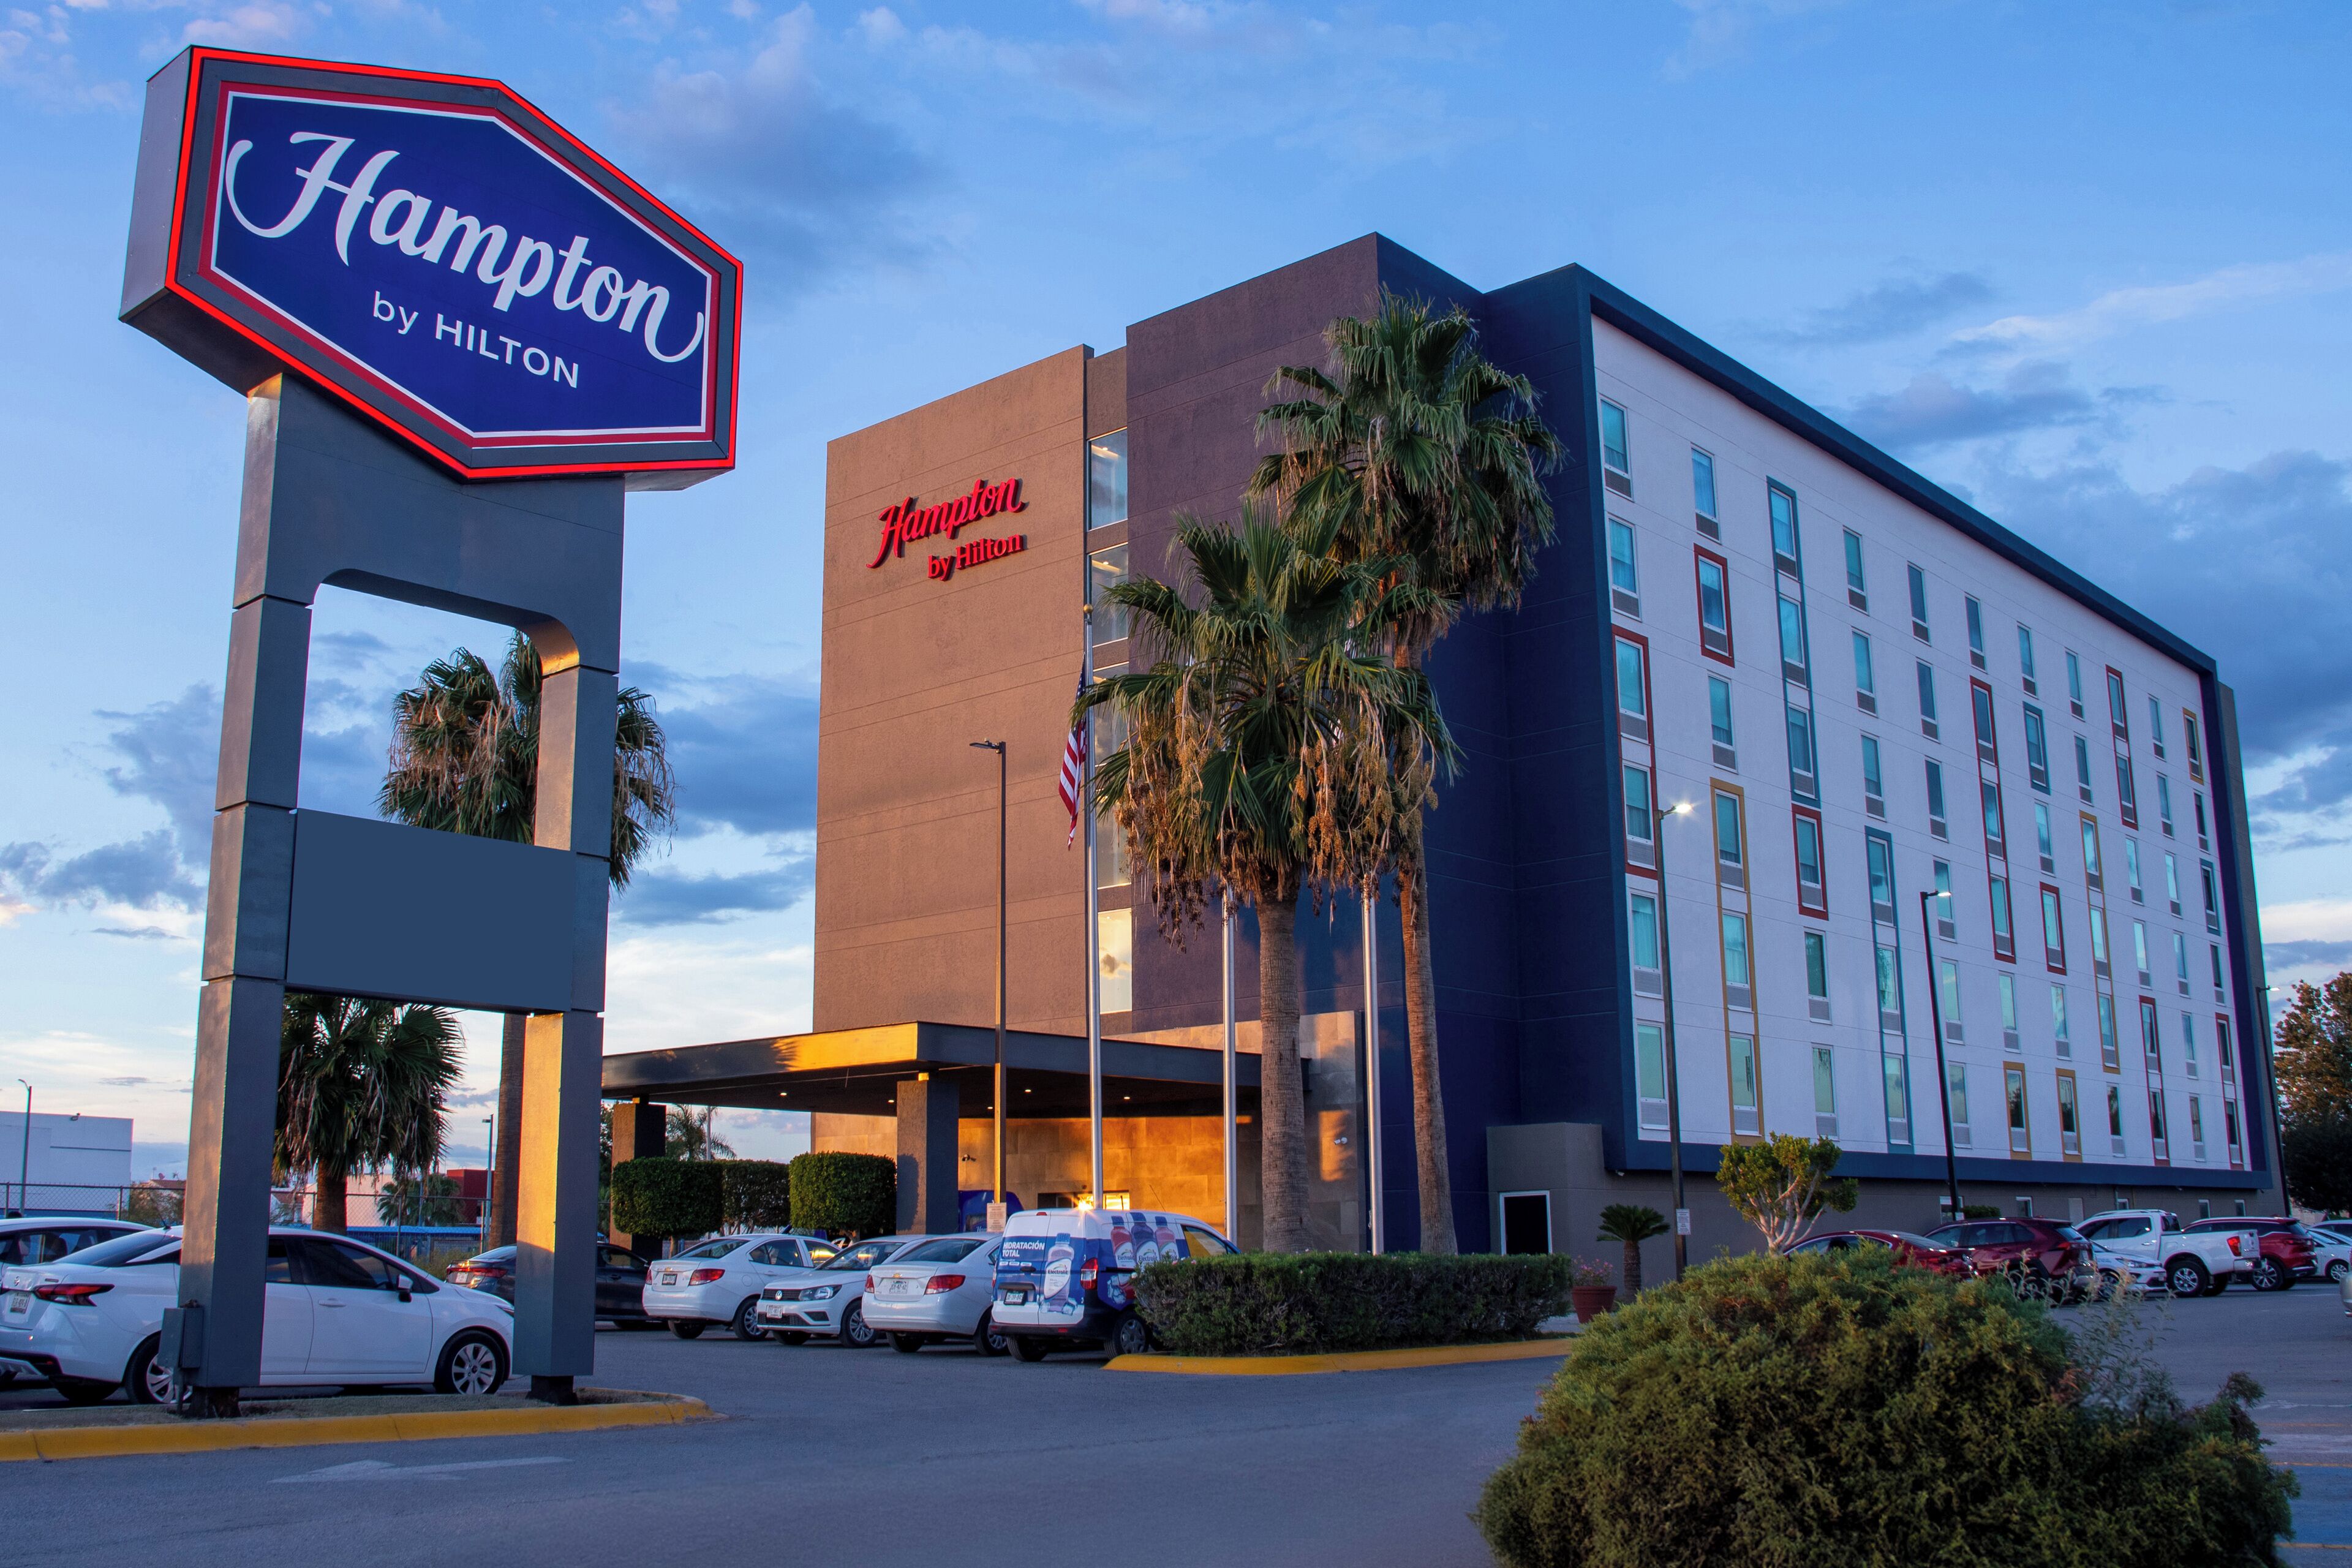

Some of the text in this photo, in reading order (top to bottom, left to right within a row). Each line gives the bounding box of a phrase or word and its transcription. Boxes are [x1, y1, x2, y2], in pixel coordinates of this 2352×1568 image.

[225, 131, 704, 363] Hampton
[373, 290, 578, 388] by HILTON
[866, 477, 1024, 568] Hampton
[927, 533, 1023, 581] by Hilton
[1003, 1240, 1045, 1250] HIDRATACIÓN
